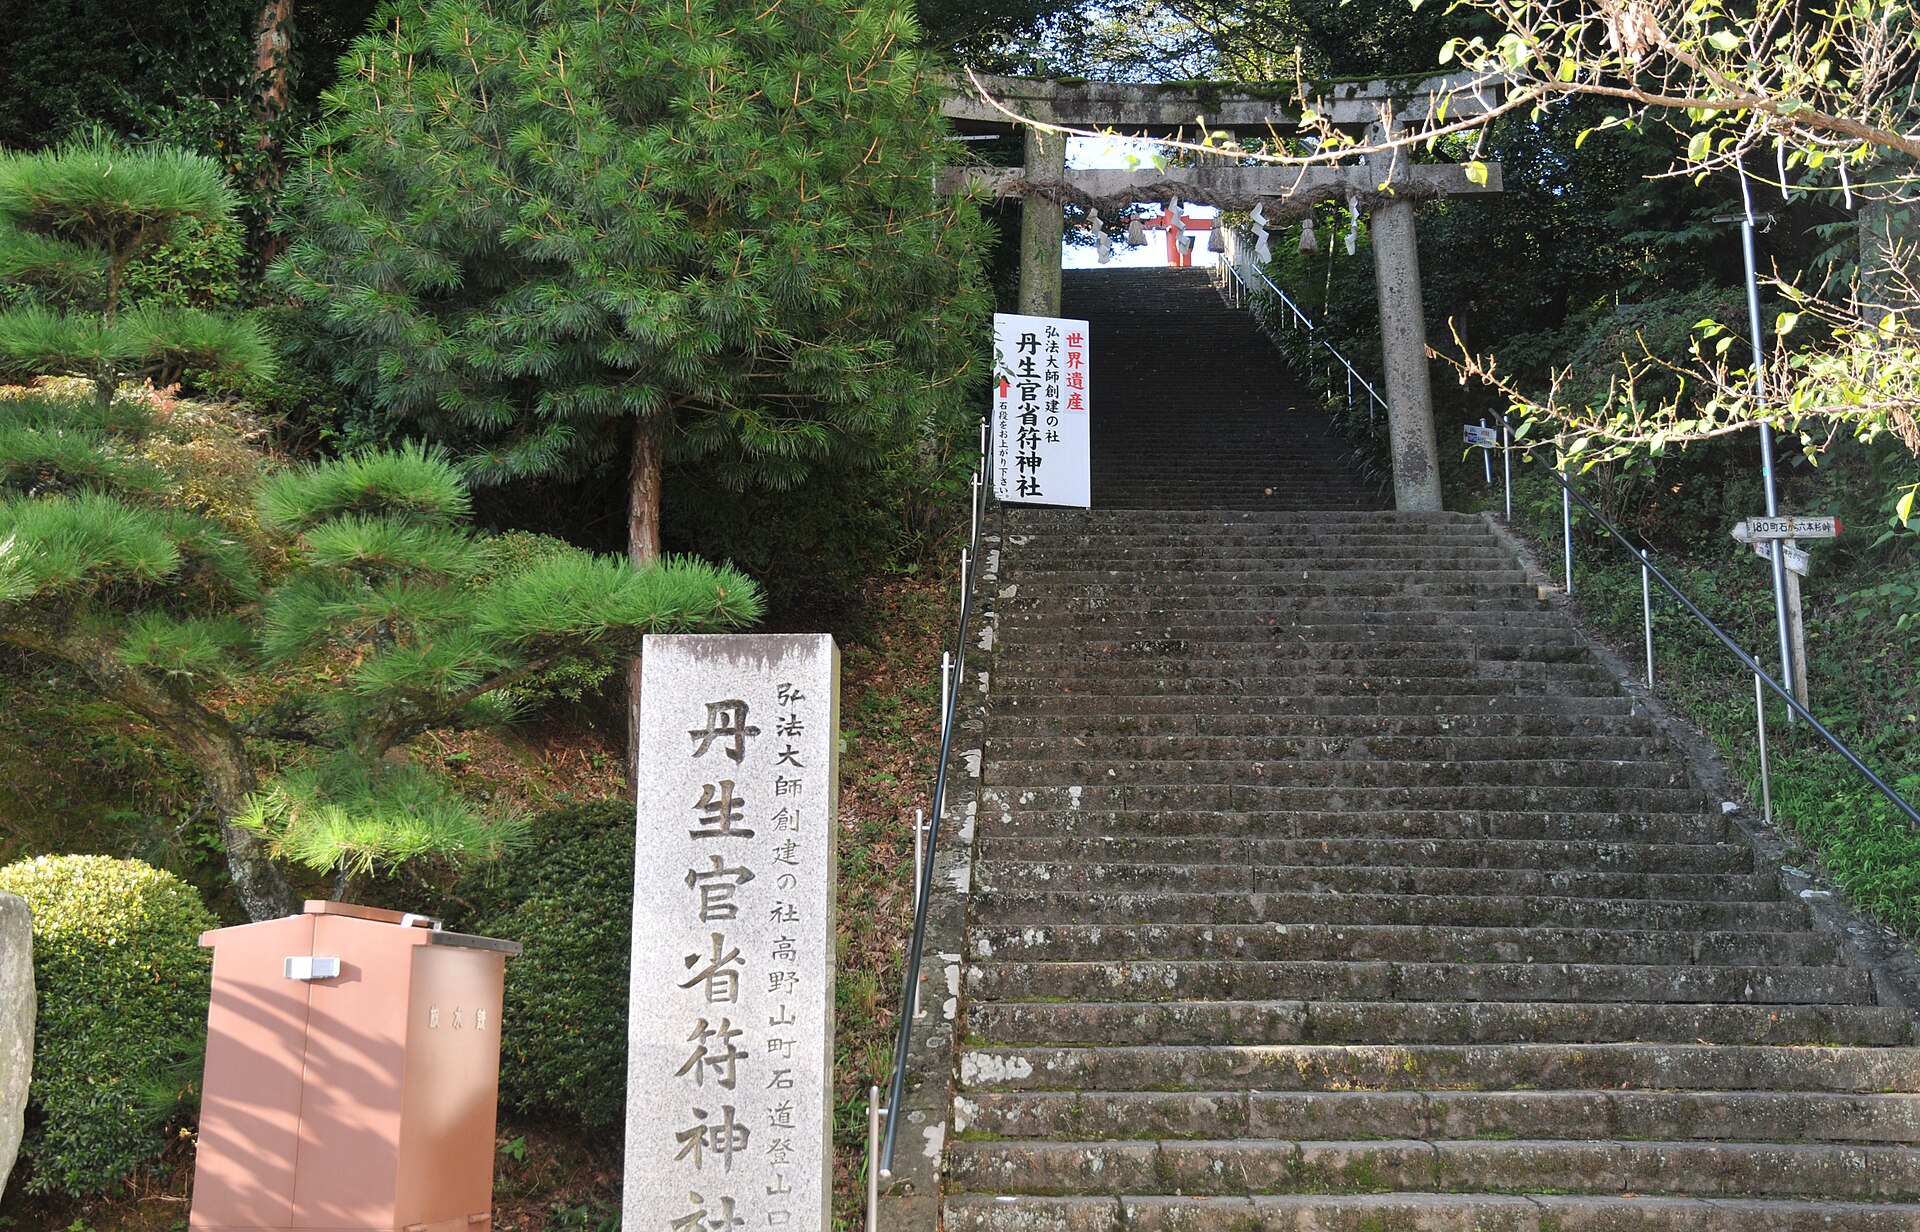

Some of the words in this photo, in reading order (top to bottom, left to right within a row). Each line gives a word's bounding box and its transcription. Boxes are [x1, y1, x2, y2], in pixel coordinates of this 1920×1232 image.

[1015, 332, 1043, 498] 丹生官省符神社
[1045, 325, 1060, 443] 弘法大師創建の社
[1065, 332, 1085, 411] 世界遺産
